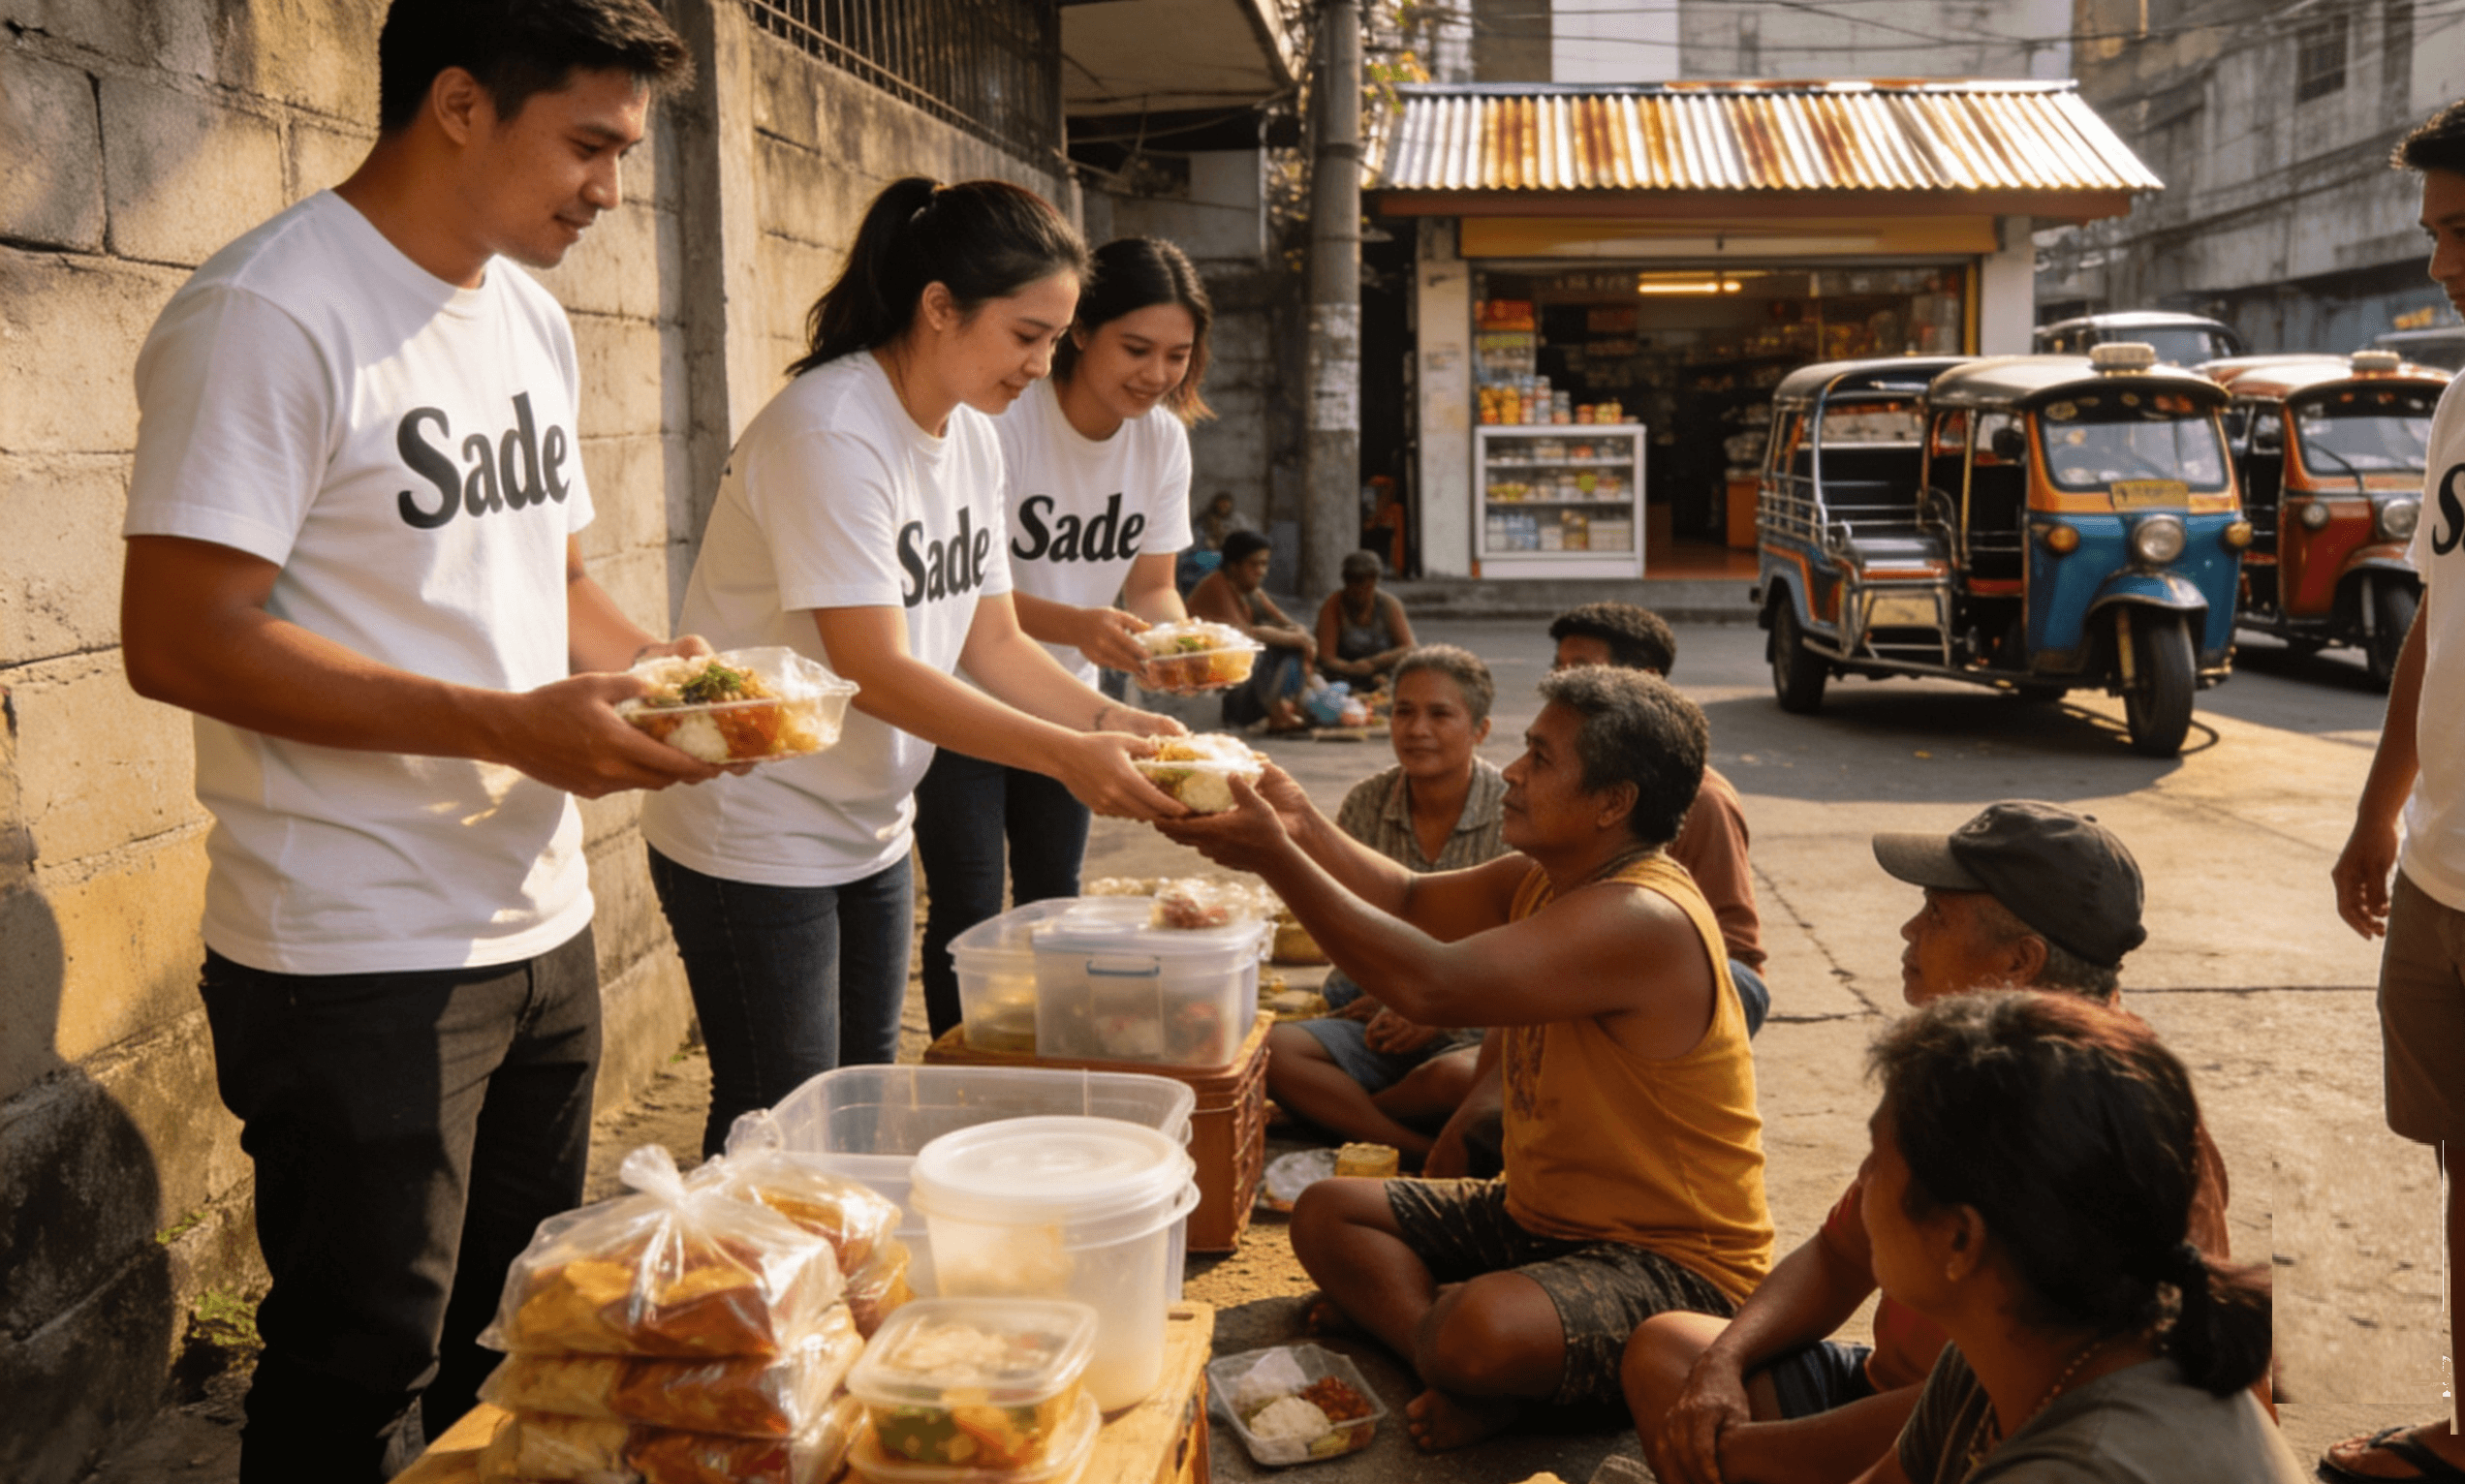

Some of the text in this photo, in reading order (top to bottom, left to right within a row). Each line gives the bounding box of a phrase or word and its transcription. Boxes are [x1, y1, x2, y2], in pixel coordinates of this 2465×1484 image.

[396, 391, 572, 529] Sade
[2431, 462, 2465, 556] S
[896, 506, 990, 608] Sade
[1011, 492, 1145, 562] Sade
